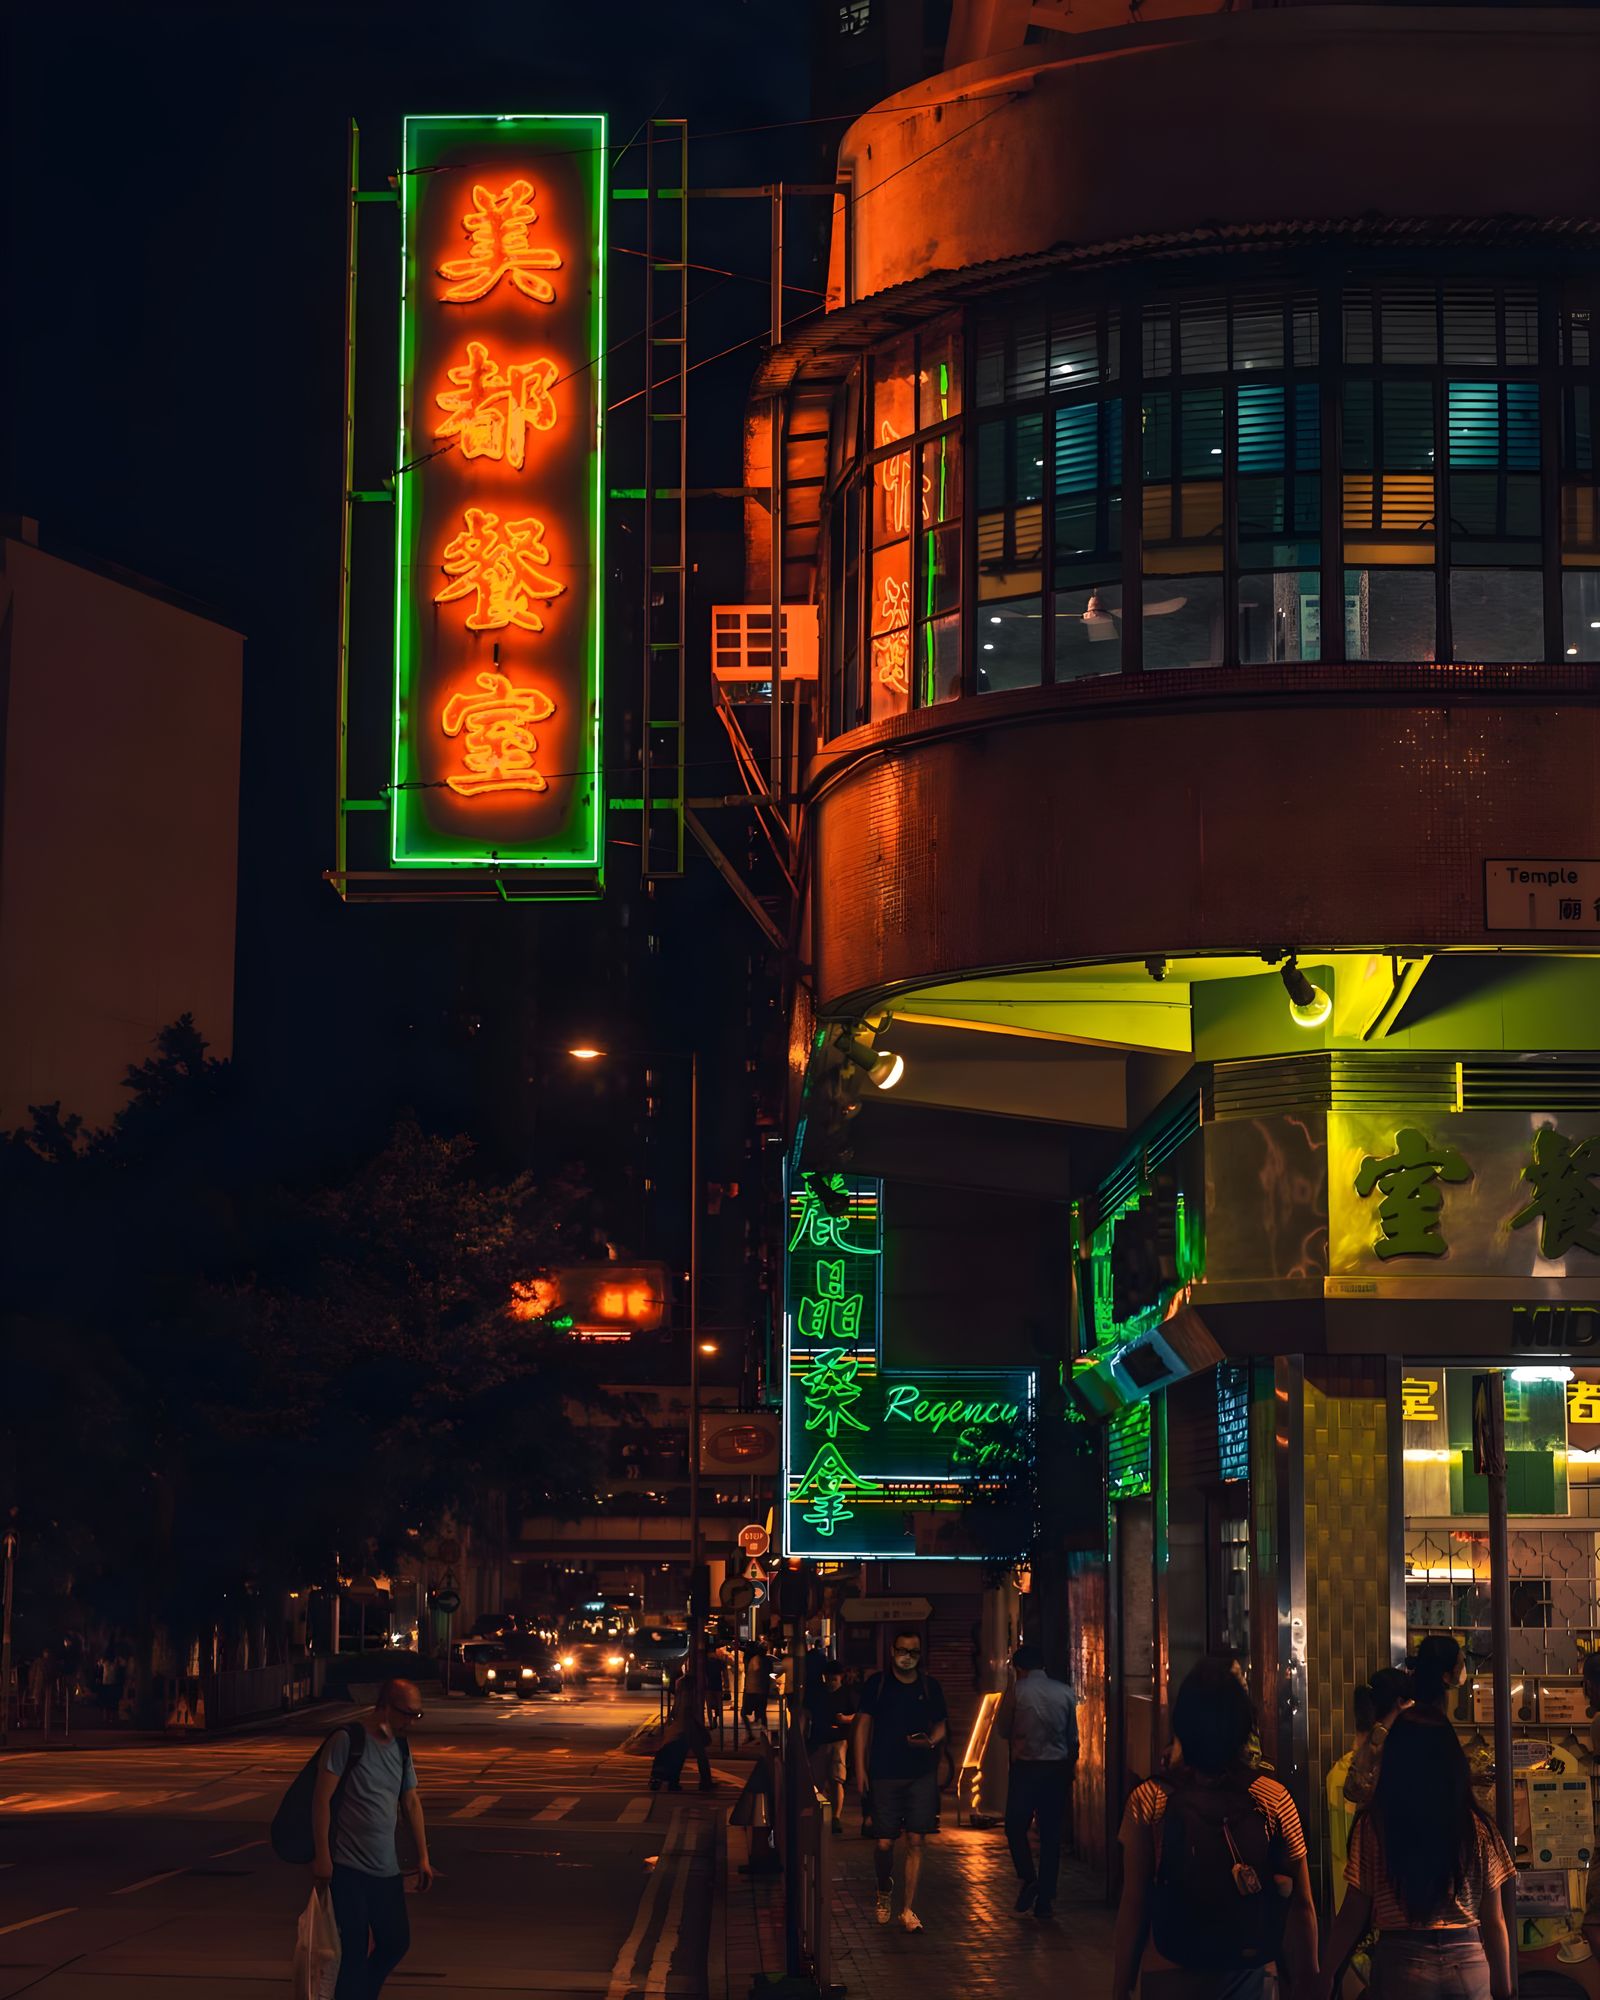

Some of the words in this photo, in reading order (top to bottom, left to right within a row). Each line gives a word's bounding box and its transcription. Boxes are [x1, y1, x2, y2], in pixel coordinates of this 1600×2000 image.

[436, 179, 568, 798] 美都餐室
[1506, 867, 1579, 887] Temple
[883, 1384, 1019, 1434] Regency
